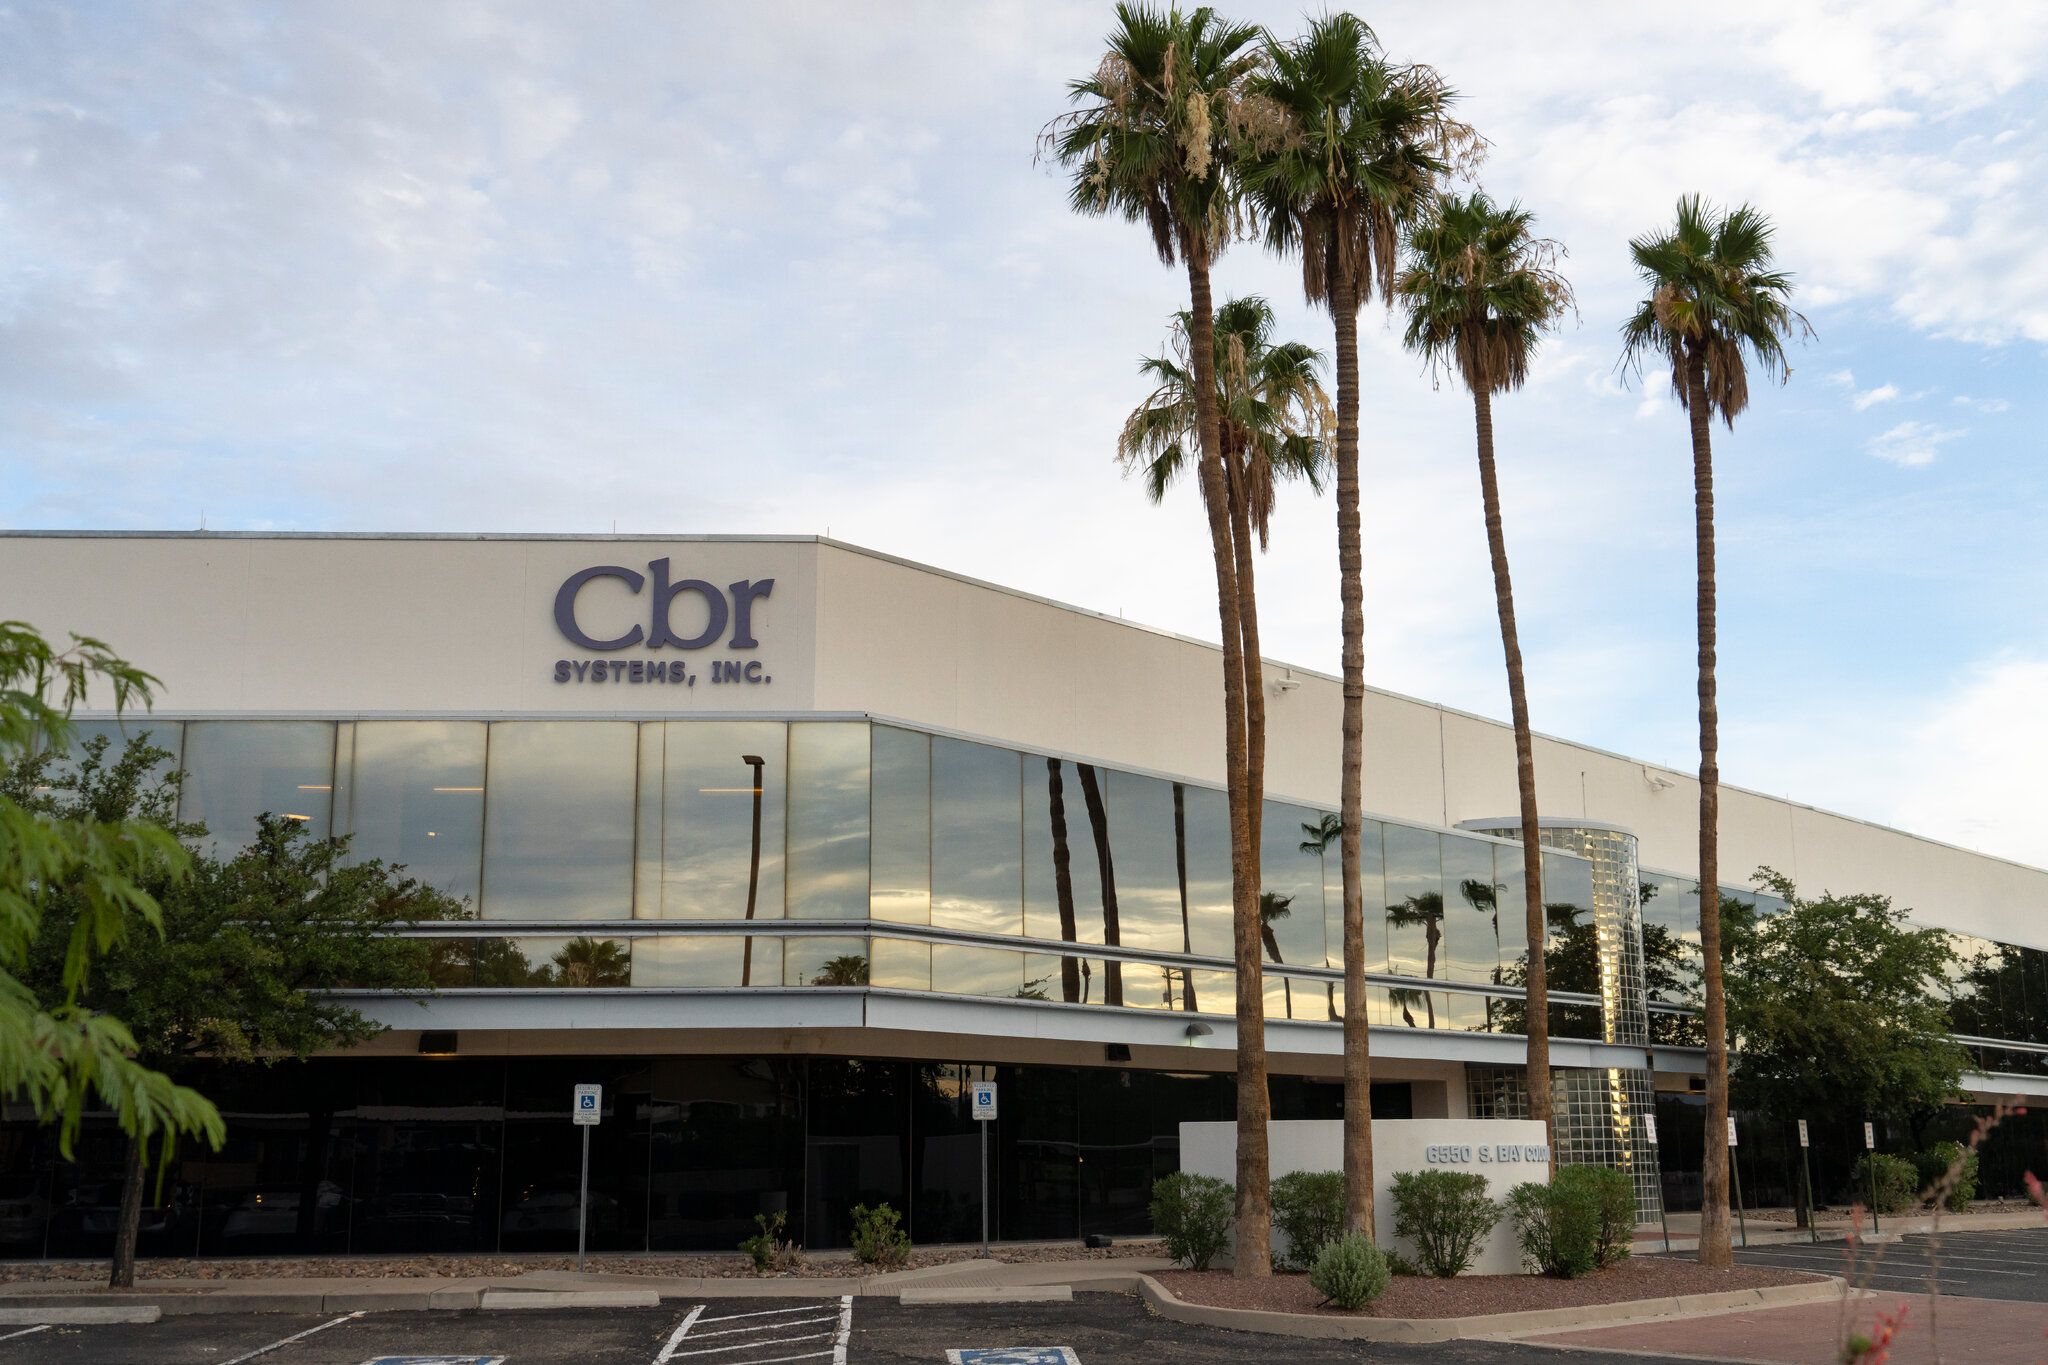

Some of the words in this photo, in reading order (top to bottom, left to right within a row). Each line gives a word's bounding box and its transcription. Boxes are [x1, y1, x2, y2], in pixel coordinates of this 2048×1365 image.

[554, 557, 775, 650] Cbr
[554, 660, 697, 686] SYSTEMS,
[711, 661, 772, 683] INC.
[1427, 1145, 1472, 1163] 6550
[1478, 1145, 1493, 1163] S.
[1496, 1145, 1523, 1162] BAY
